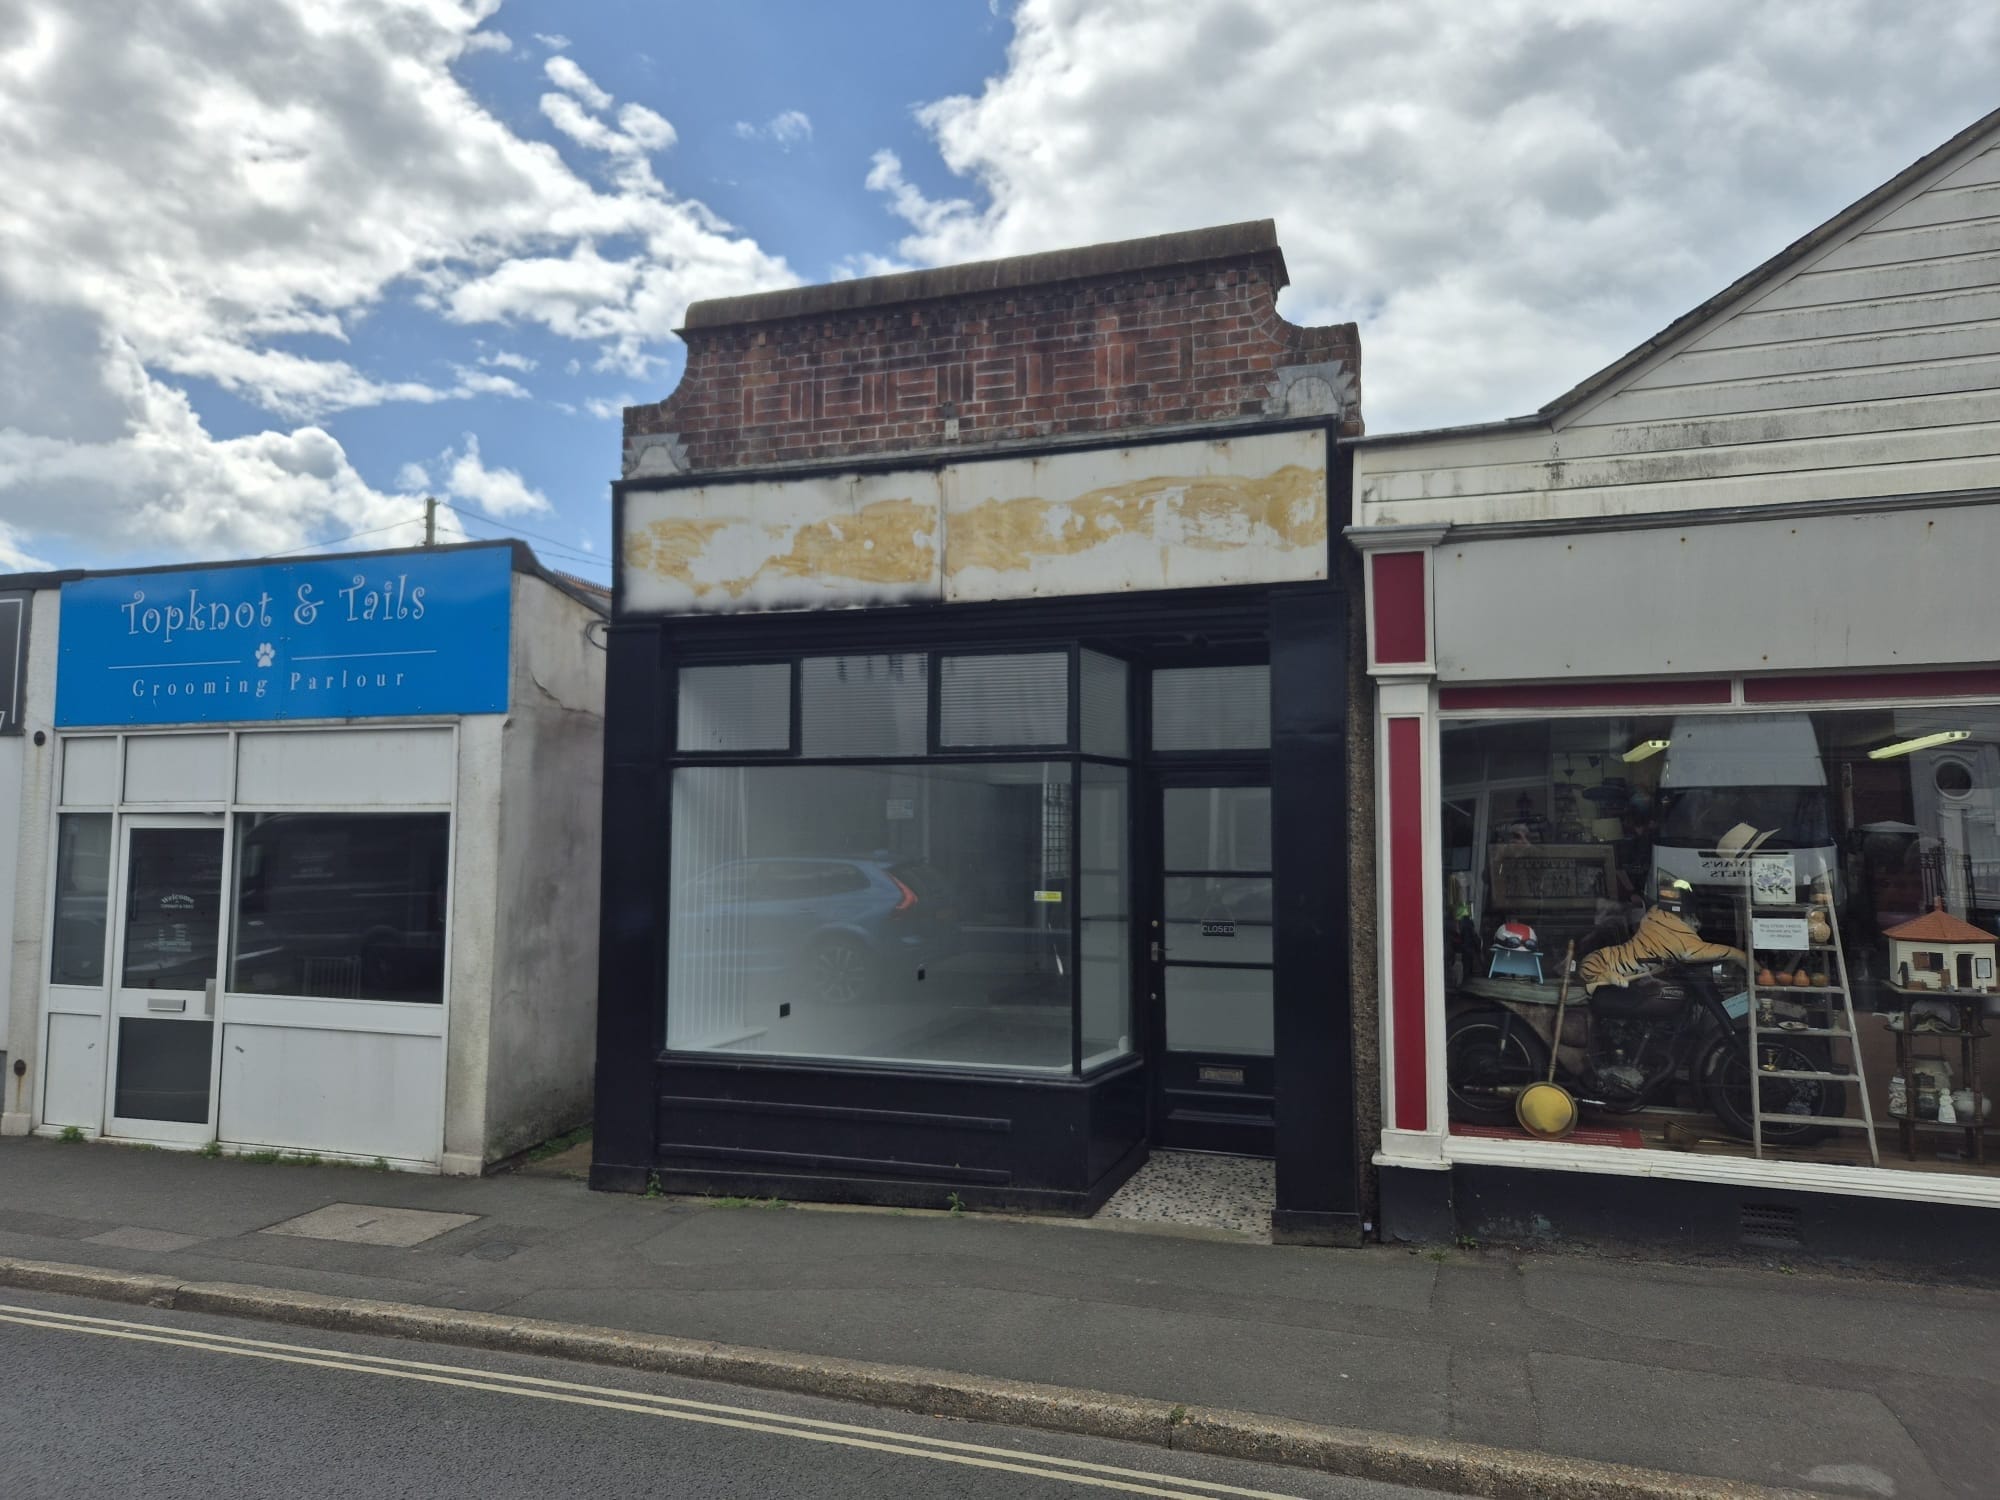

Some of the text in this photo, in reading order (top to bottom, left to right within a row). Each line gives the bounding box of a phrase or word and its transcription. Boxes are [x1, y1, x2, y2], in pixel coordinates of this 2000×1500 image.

[121, 574, 426, 643] Topknot & Tails
[132, 669, 404, 698] Grooming Parlour
[1201, 925, 1235, 933] CLOSED
